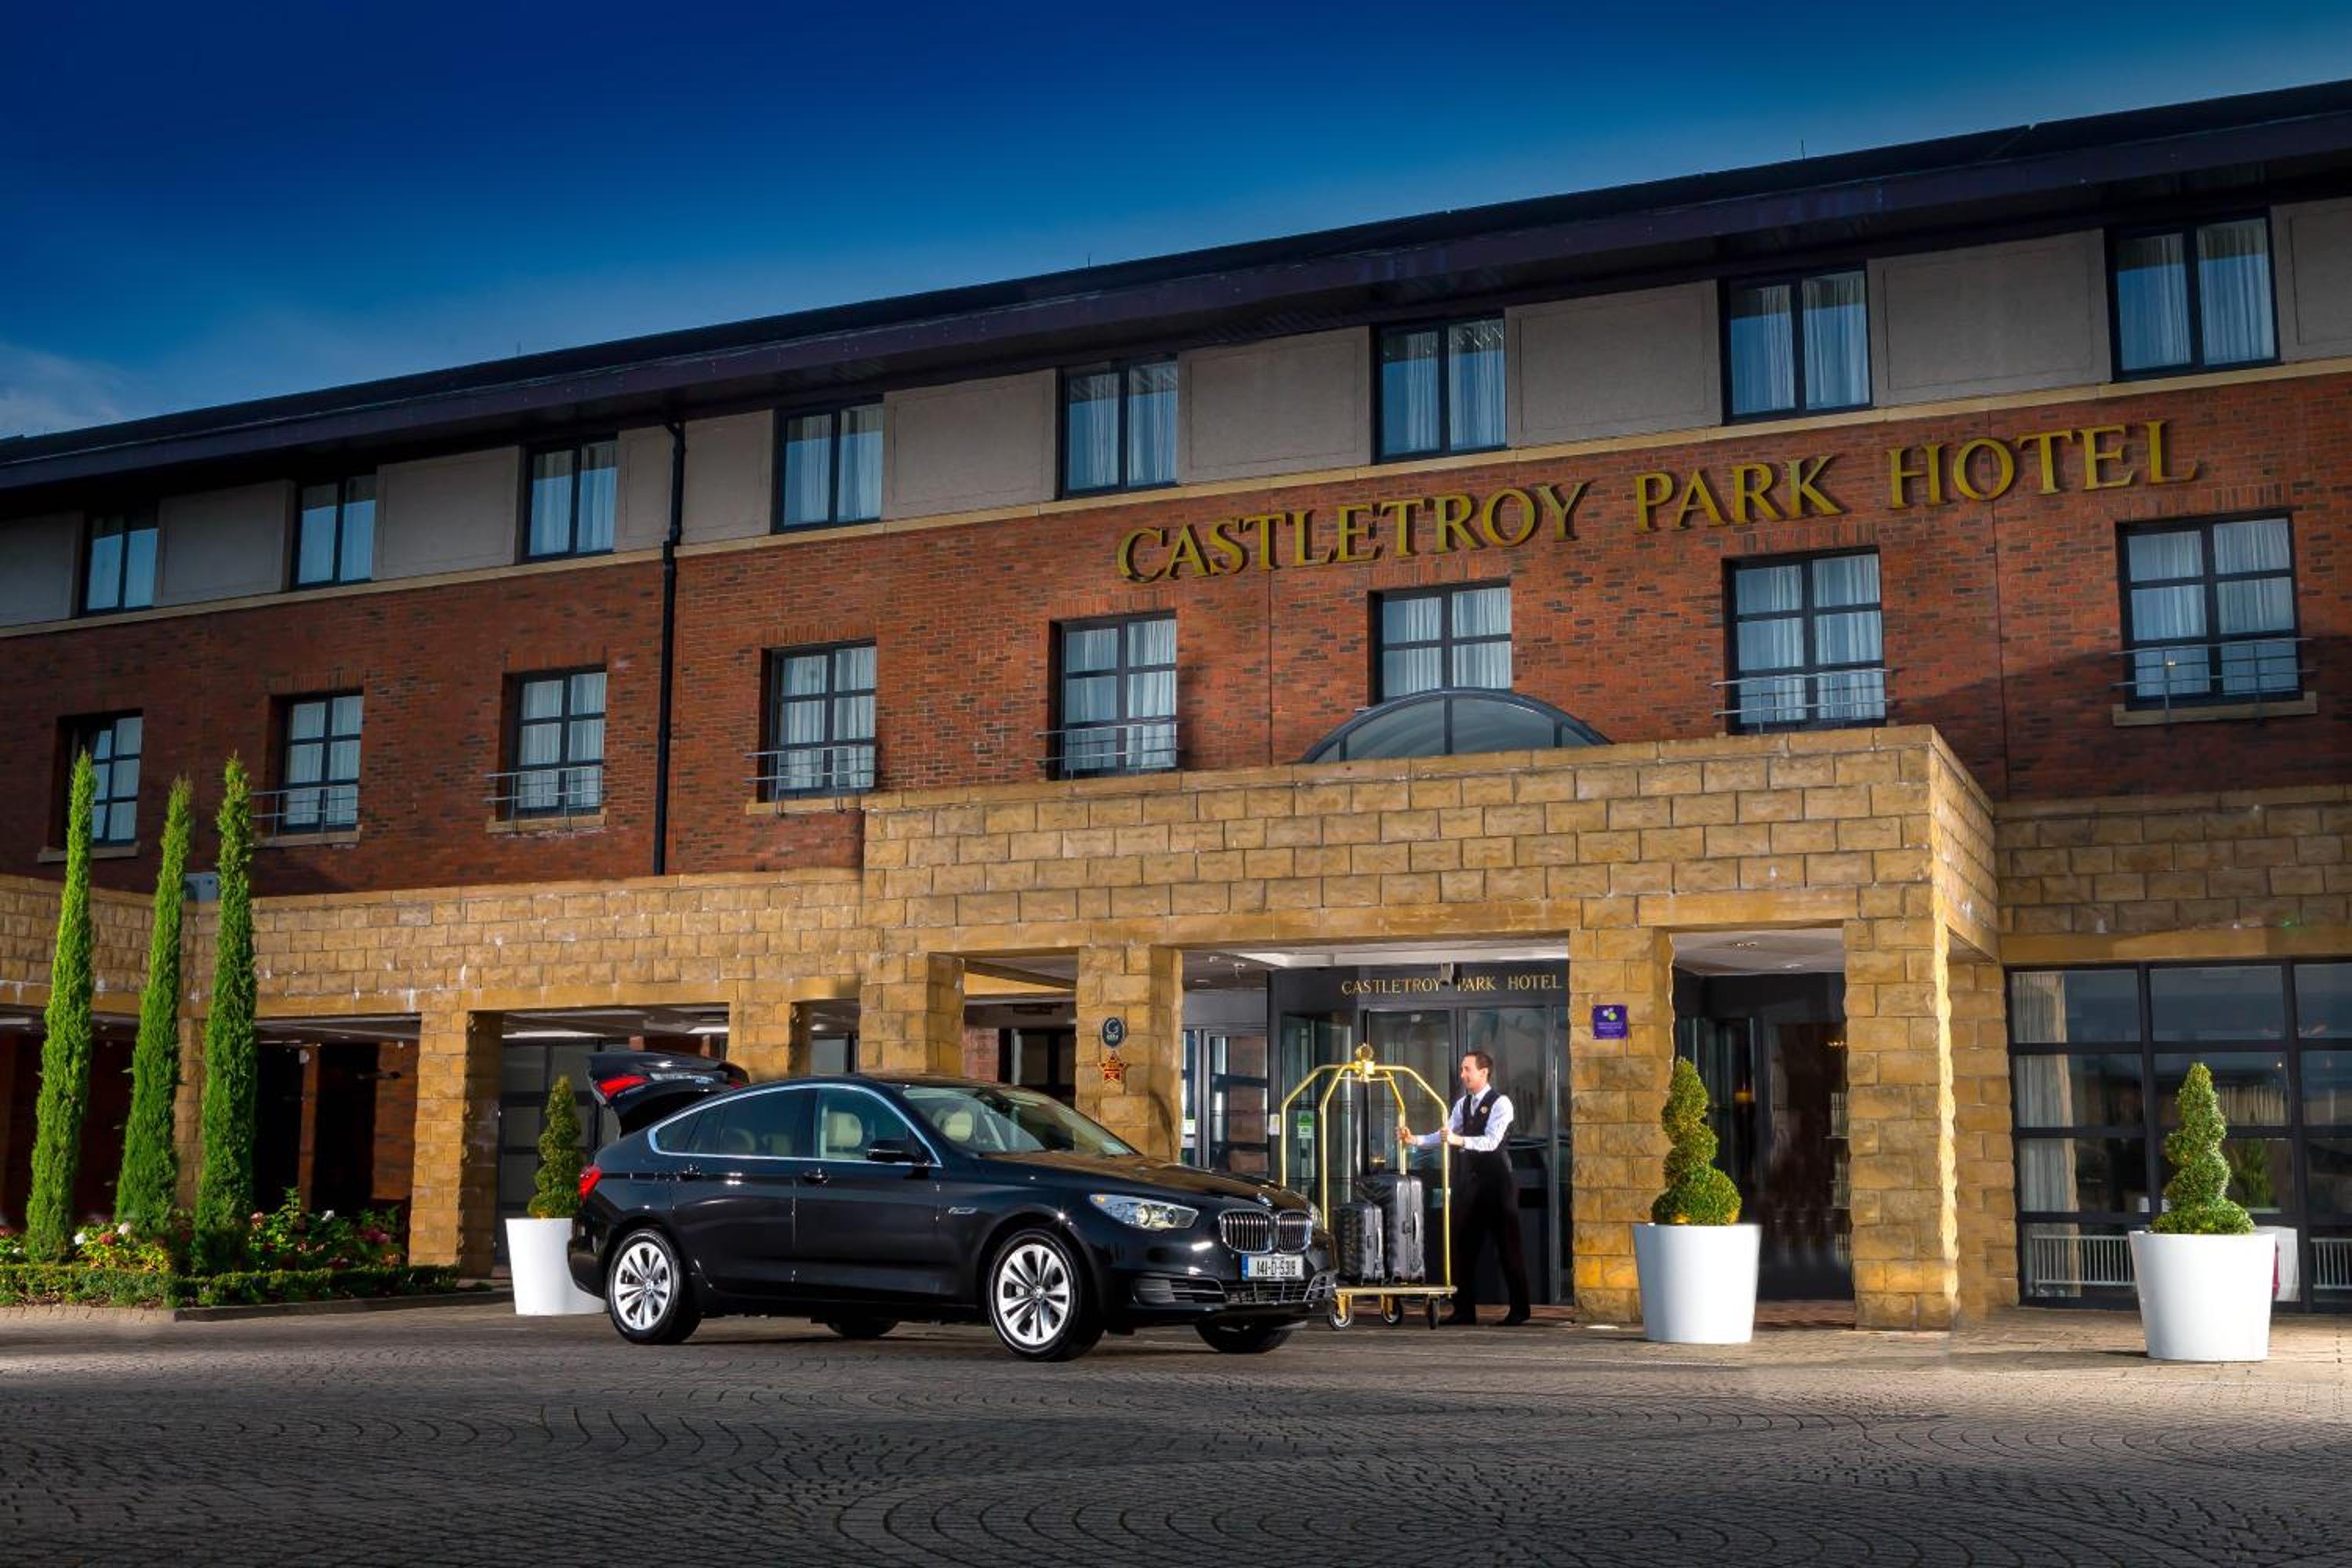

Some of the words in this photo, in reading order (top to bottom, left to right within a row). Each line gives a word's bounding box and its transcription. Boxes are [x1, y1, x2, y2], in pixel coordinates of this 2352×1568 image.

[1117, 480, 1590, 583] CASTLETROY
[1634, 453, 1846, 534] PARK
[1886, 419, 2200, 510] HOTEL
[1341, 978, 1440, 995] CASTLETROY
[1457, 975, 1497, 992] PARK
[1507, 974, 1563, 991] HOTEL
